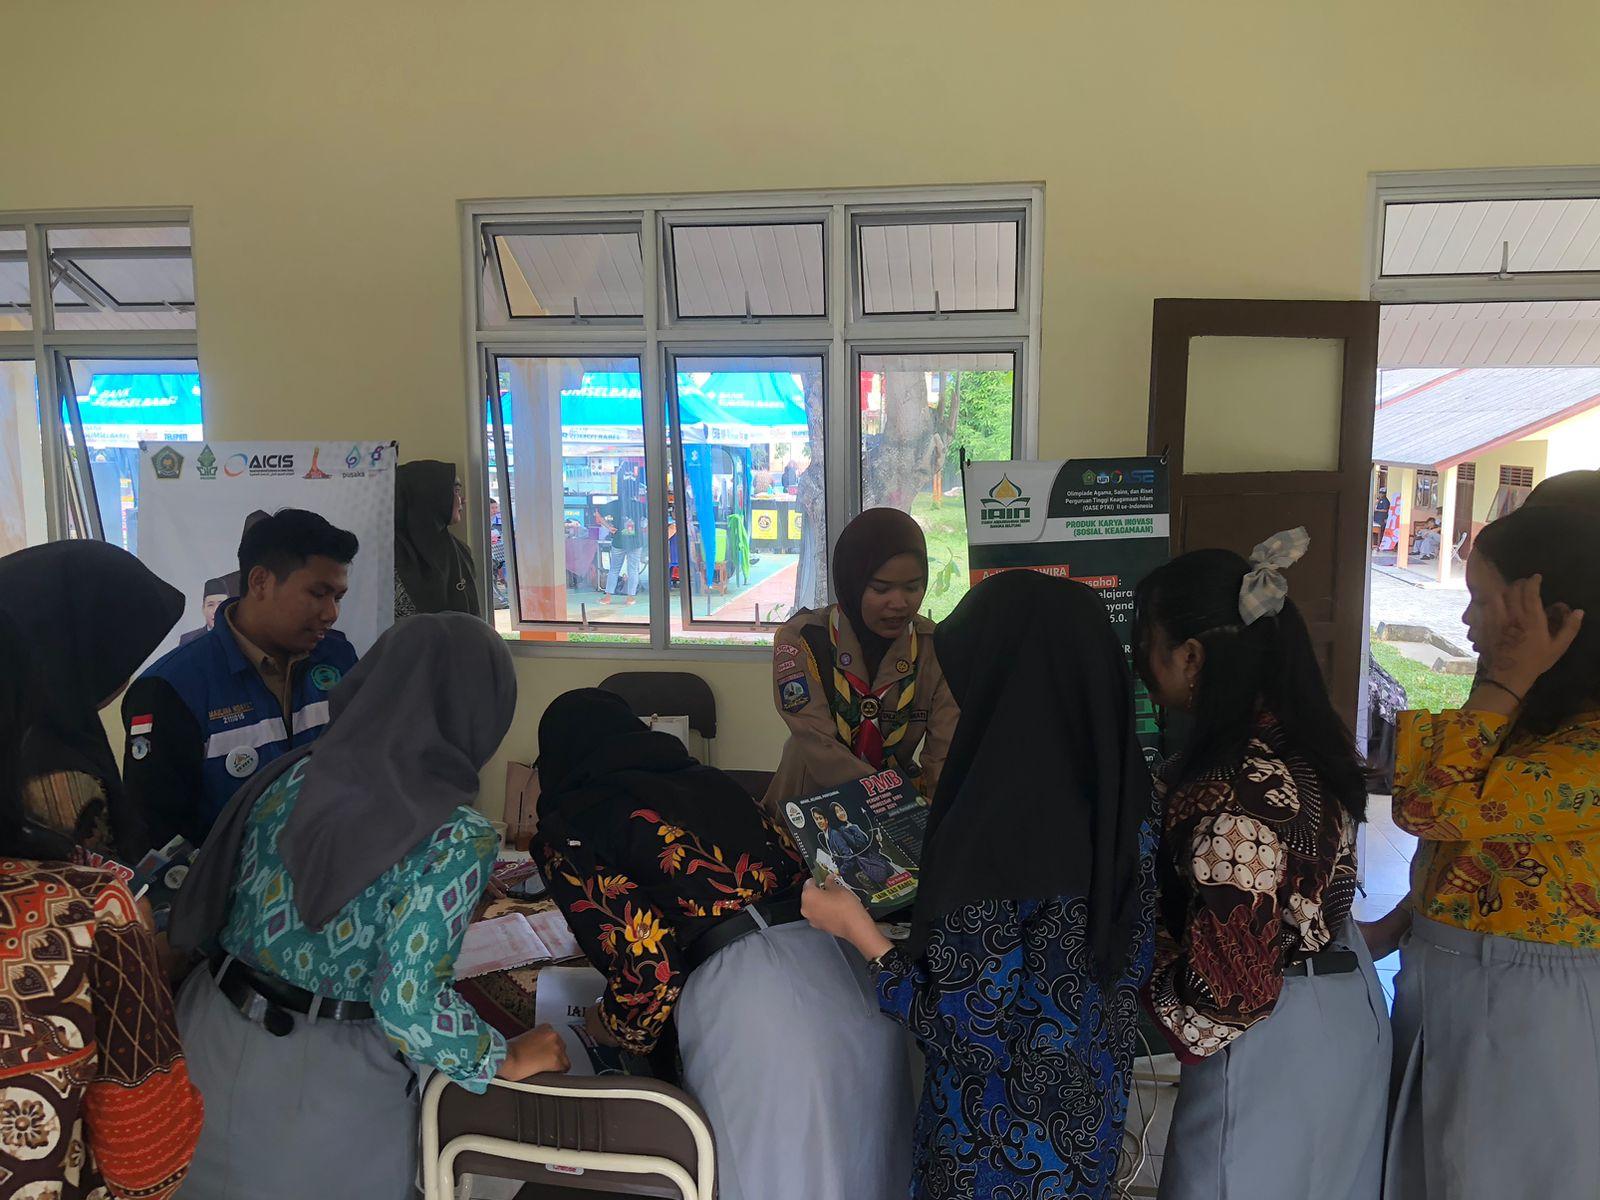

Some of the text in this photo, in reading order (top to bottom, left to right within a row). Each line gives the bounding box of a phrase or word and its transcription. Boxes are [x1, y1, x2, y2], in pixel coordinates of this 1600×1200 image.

[249, 454, 294, 469] AICIS
[1093, 489, 1113, 497] Agama,
[1109, 496, 1139, 504] Keagamaan
[981, 507, 1030, 520] IAIN
[1065, 517, 1154, 529] PRODUK KARYA INOVASI
[1073, 525, 1154, 537] (SOSIAL KEAGAMAAN)
[1109, 614, 1128, 623] 5.0.
[859, 769, 904, 797] PMB
[567, 1004, 586, 1018] IAI
